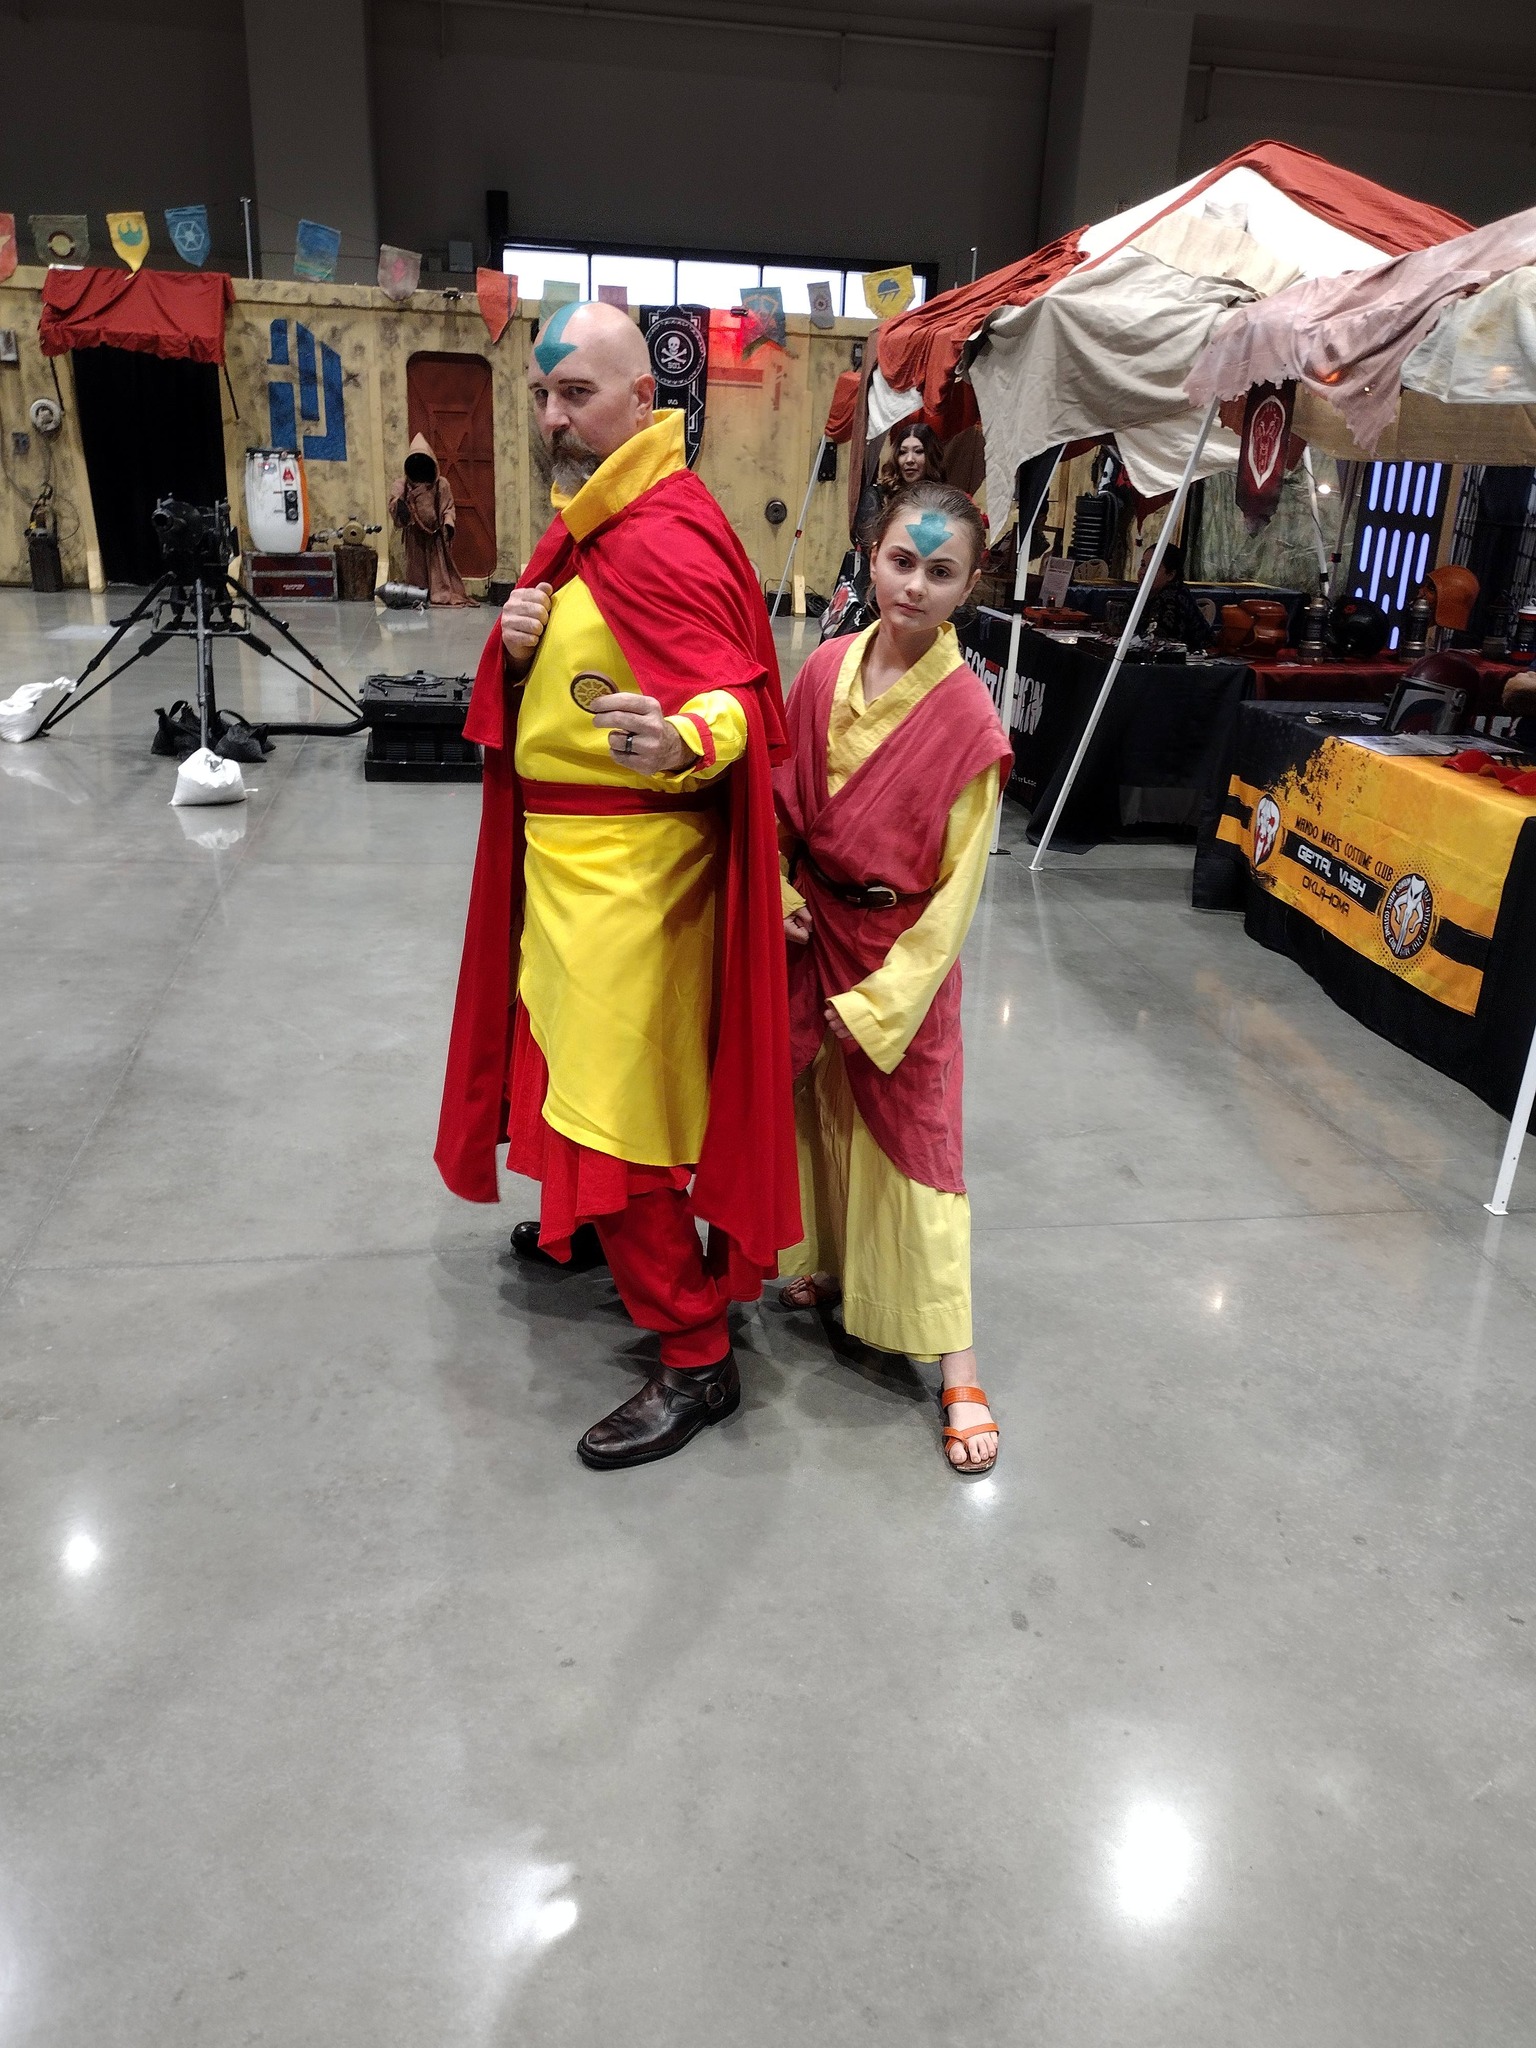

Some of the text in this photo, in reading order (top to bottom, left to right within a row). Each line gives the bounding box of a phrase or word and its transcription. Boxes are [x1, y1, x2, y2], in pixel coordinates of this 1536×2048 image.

[1295, 816, 1319, 839] MANDO
[1345, 843, 1373, 871] COSTUME
[1374, 860, 1394, 882] CLUB
[1302, 875, 1349, 917] OKLAHOMA
[1339, 867, 1367, 898] VHEH
